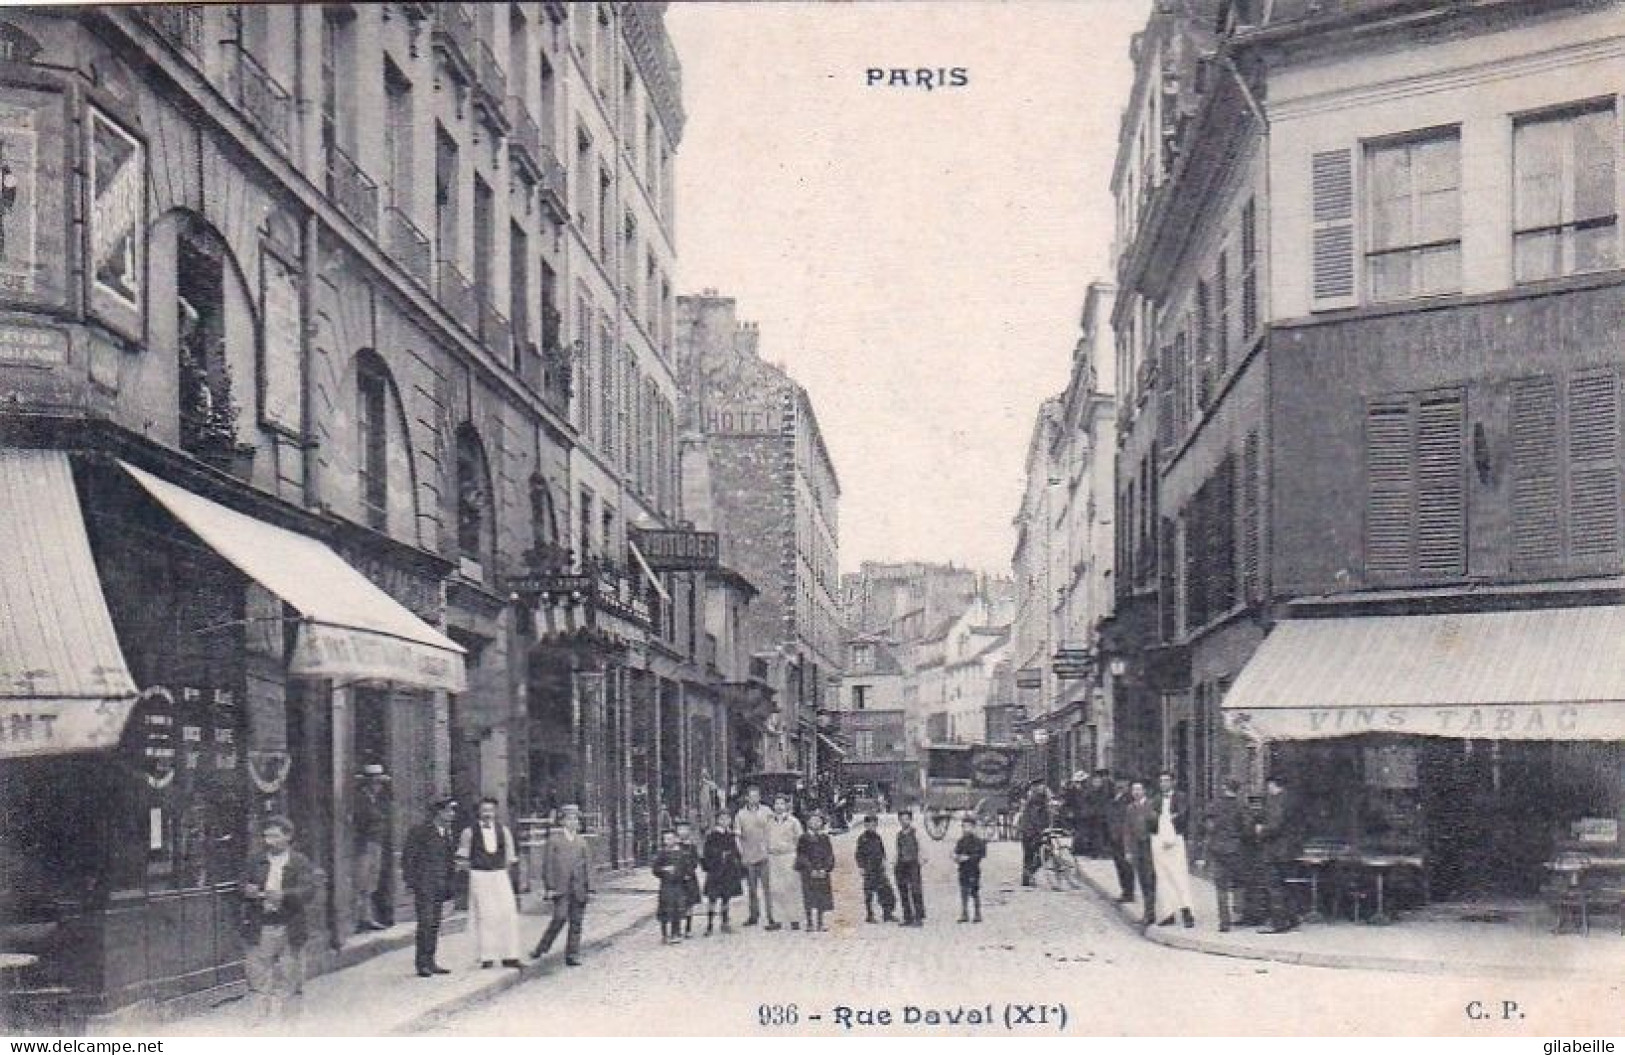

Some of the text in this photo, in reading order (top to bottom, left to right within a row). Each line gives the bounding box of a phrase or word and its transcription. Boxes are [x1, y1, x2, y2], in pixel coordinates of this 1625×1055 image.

[706, 407, 779, 432] HOTEL
[1308, 706, 1576, 731] VINS TABAC
